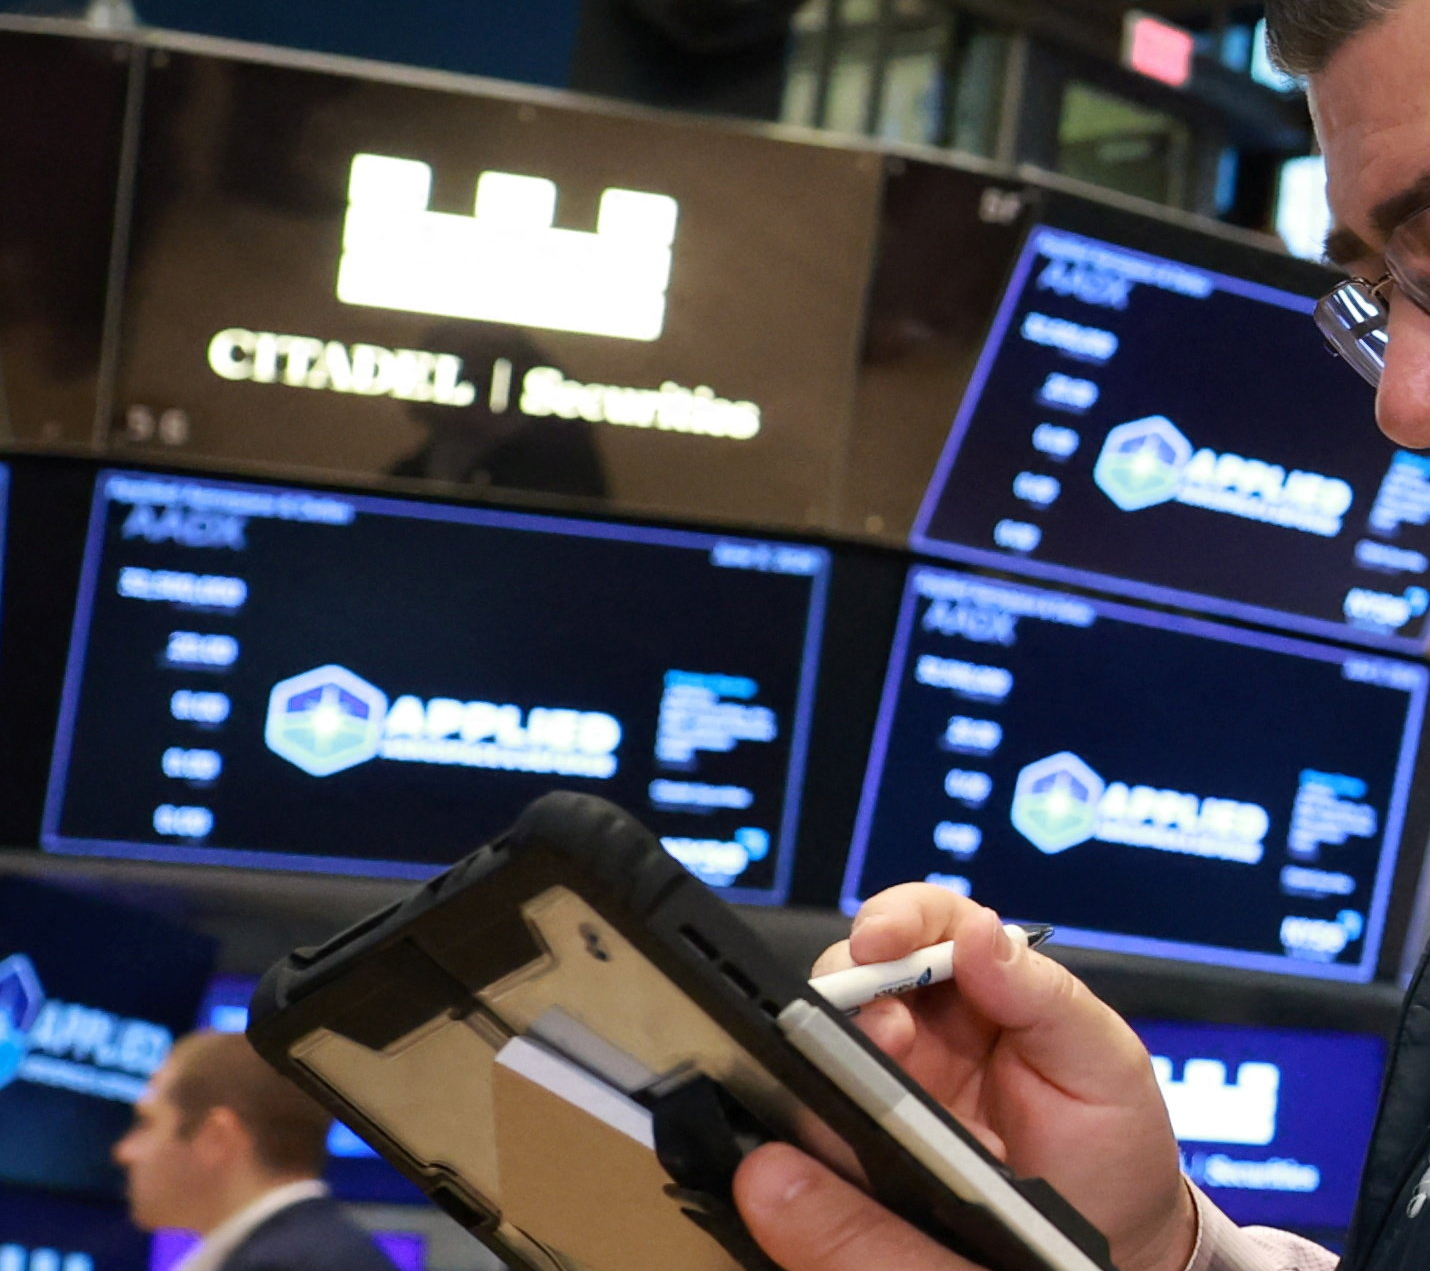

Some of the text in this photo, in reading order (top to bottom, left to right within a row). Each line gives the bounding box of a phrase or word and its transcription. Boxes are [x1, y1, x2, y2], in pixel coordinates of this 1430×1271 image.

[208, 327, 761, 440] CITADEL Securities
[1183, 448, 1353, 517] APPLIED
[386, 695, 622, 755] APPLIED
[1101, 782, 1269, 841] APPLIED
